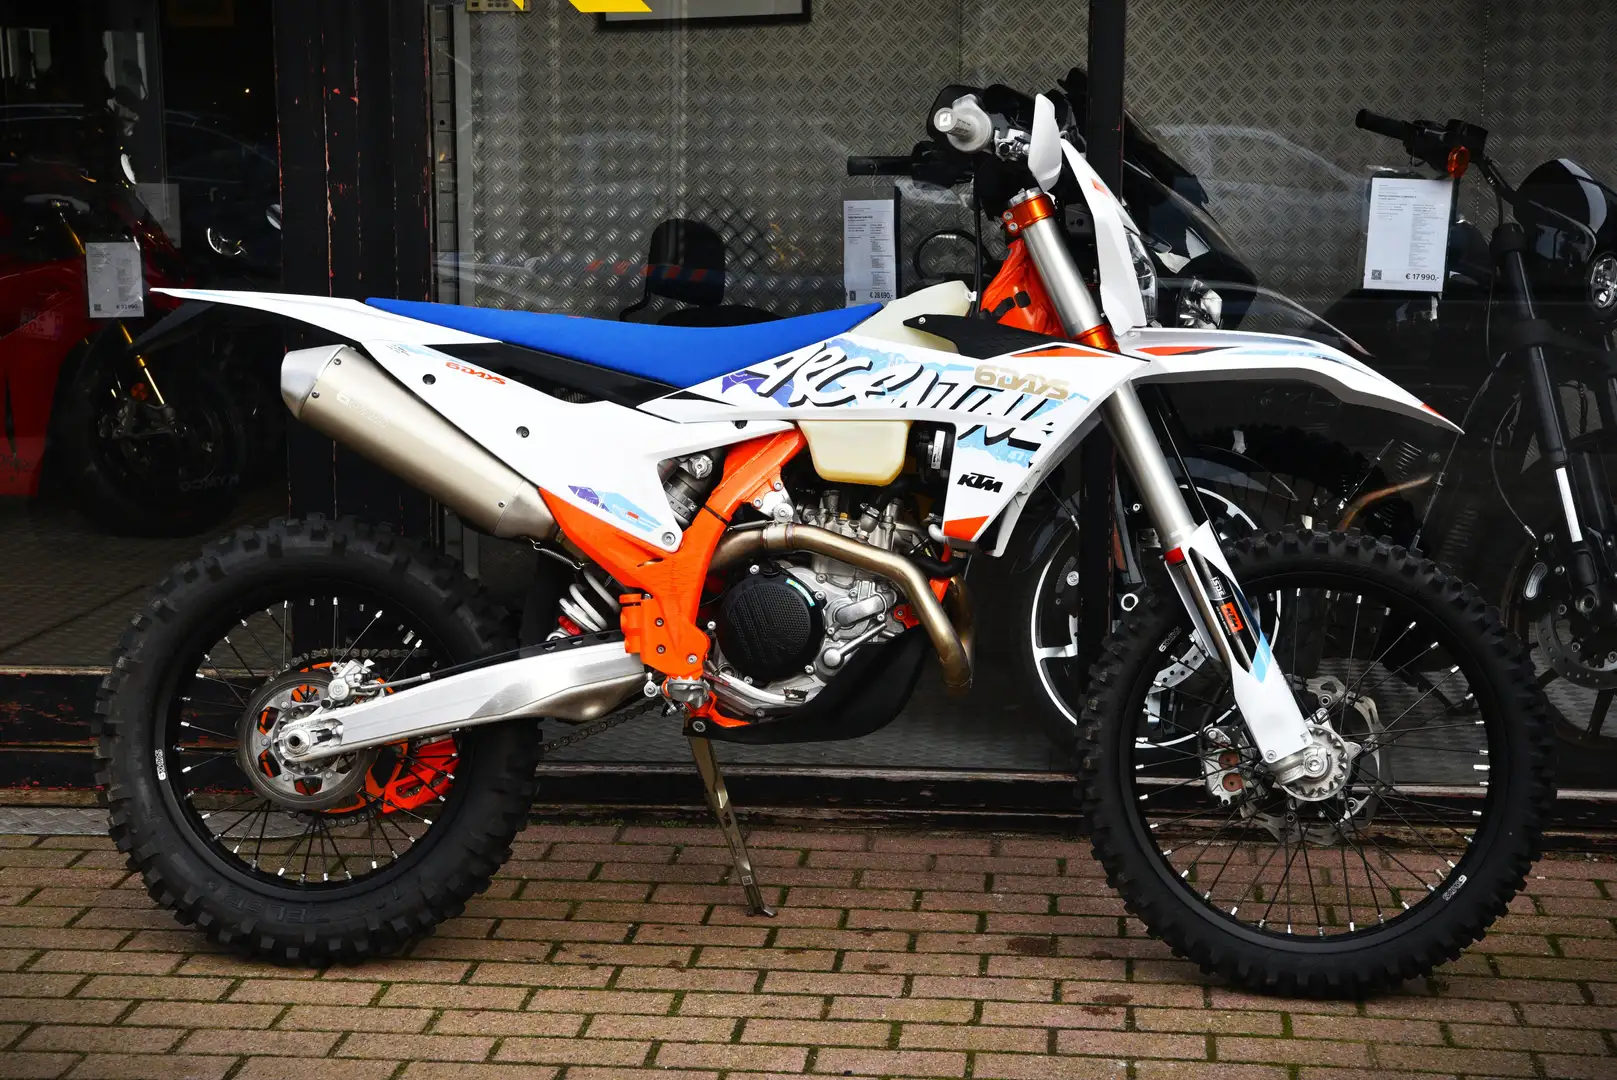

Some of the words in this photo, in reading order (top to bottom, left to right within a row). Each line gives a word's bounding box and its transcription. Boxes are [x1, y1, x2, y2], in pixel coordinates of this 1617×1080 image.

[445, 361, 506, 385] 6DAYS
[975, 364, 1069, 400] 6DAYS
[957, 472, 1003, 493] KTM
